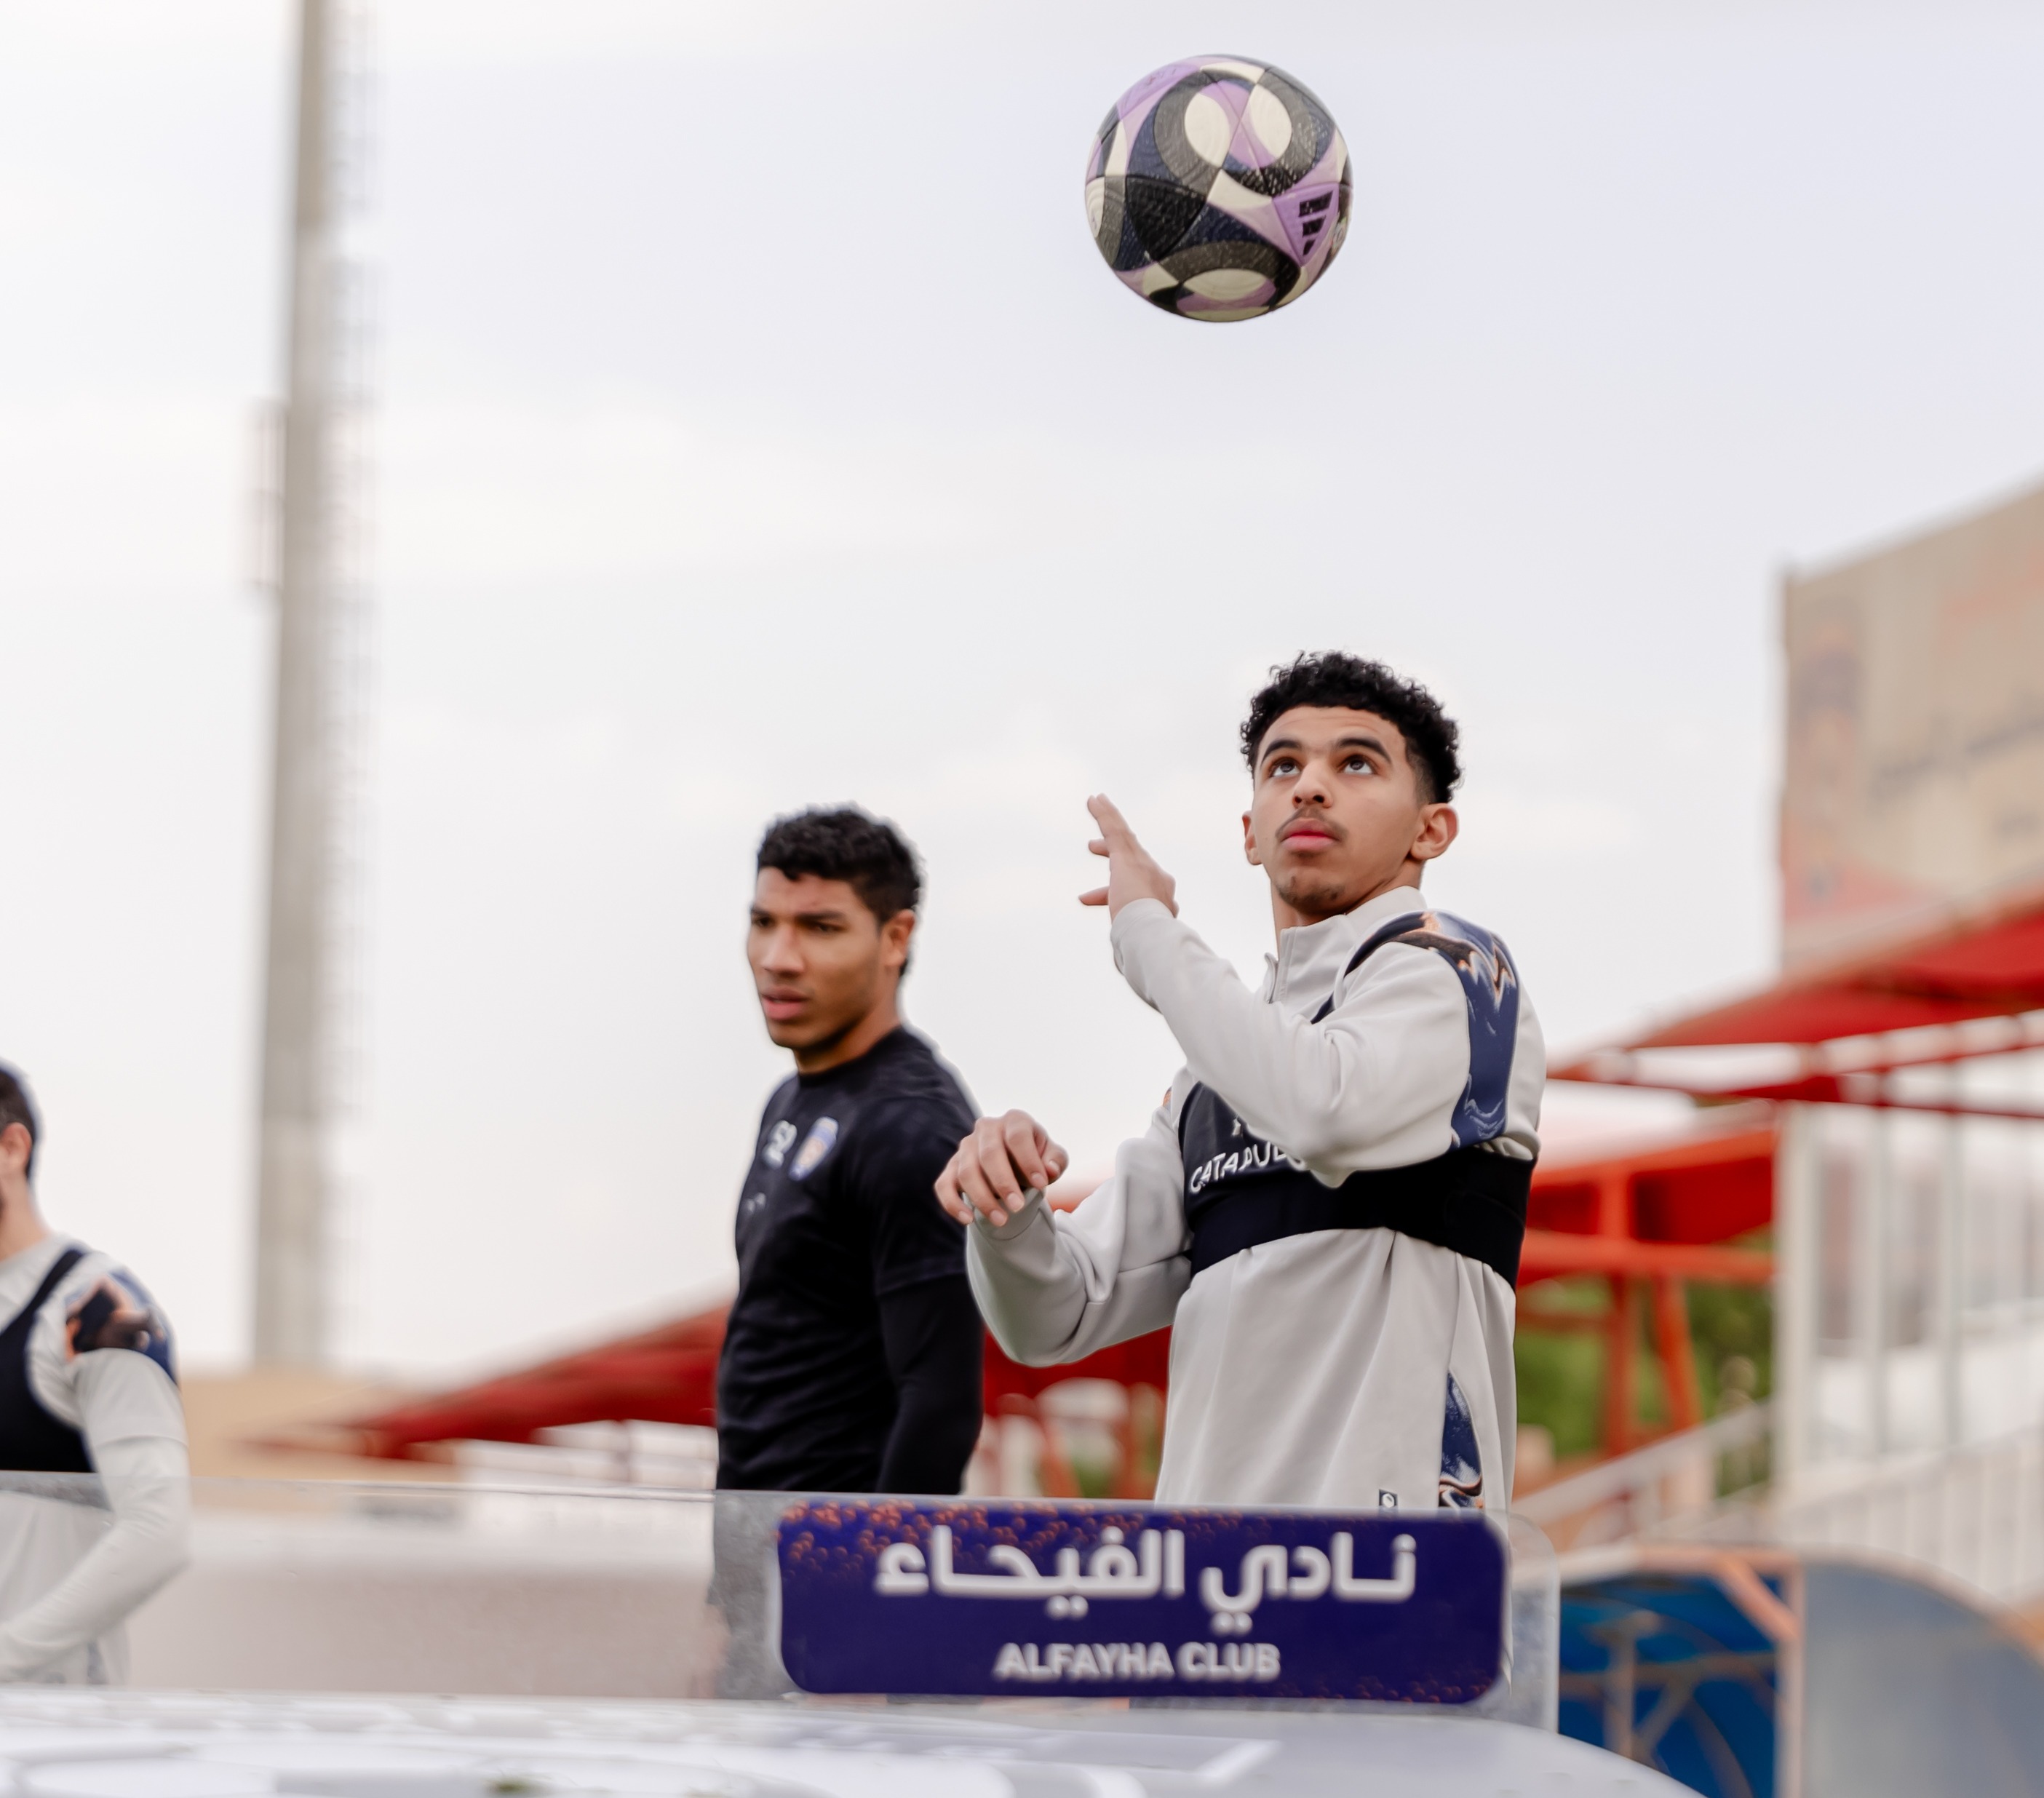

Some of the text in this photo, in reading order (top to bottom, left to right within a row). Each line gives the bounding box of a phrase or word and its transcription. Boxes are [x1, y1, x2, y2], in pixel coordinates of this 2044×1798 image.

[1190, 1140, 1287, 1193] CATAPUL
[877, 1524, 1417, 1636] نادي الفيحاء
[993, 1641, 1281, 1682] ALFAYHA CLUB
